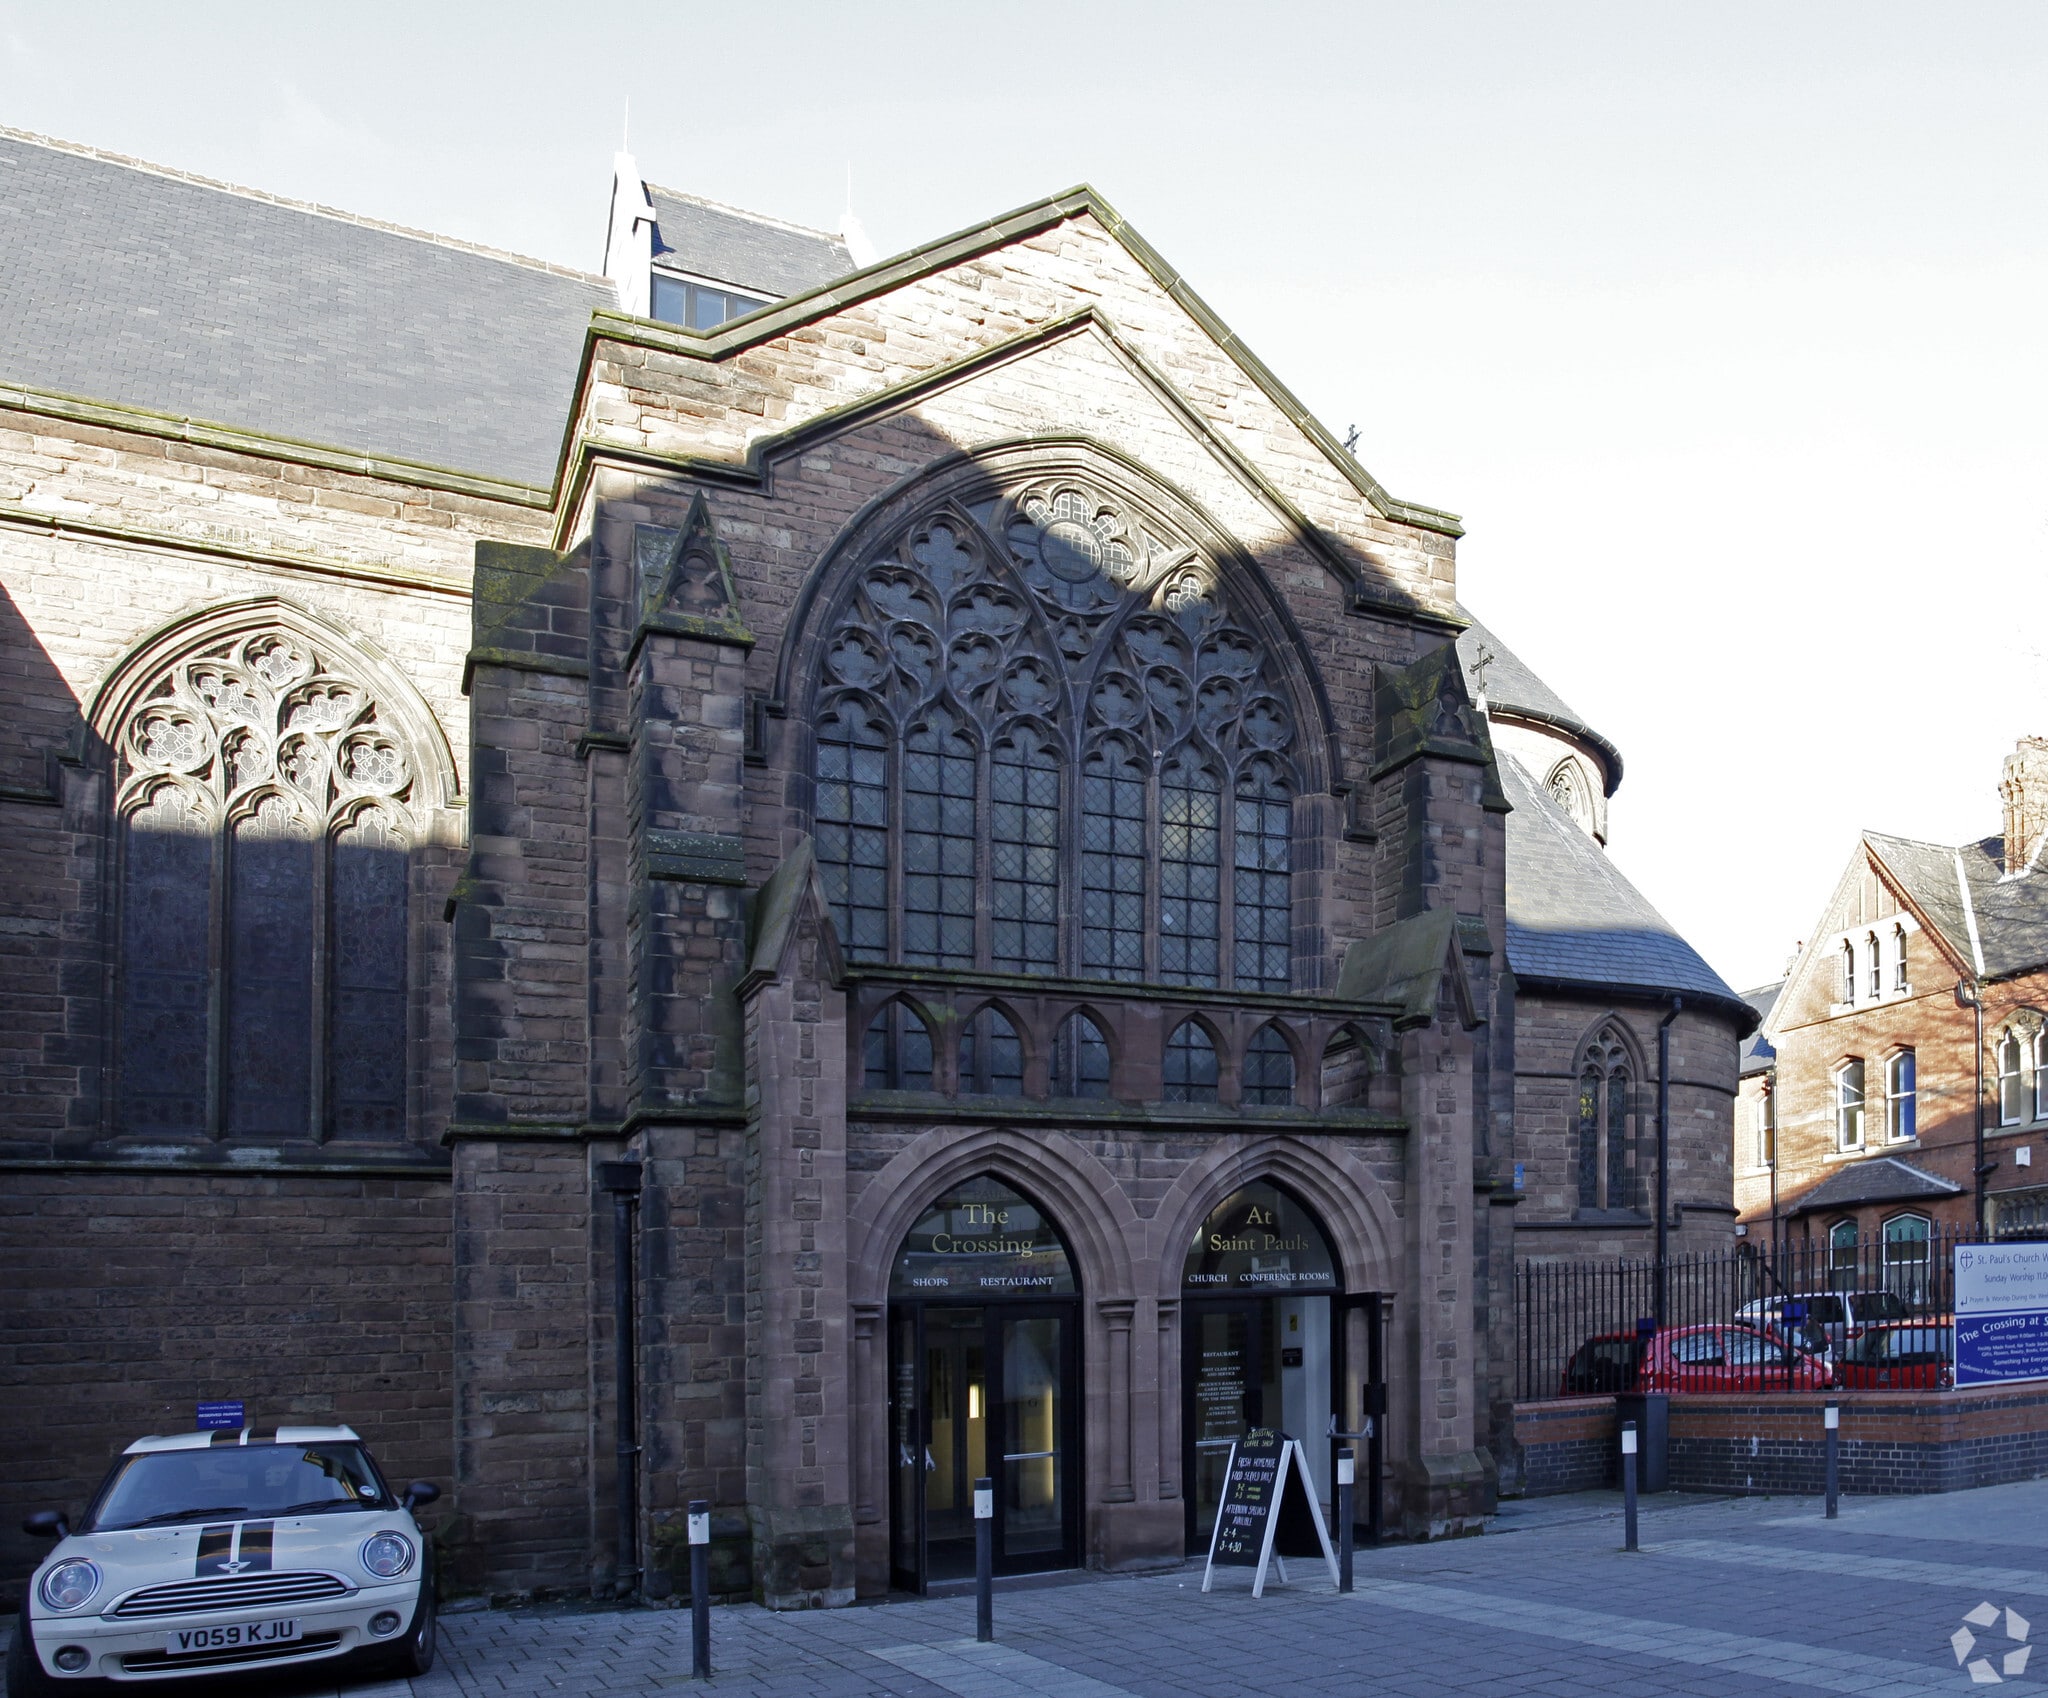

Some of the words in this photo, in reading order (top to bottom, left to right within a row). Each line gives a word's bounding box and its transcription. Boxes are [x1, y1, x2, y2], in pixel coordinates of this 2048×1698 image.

[962, 1203, 1009, 1224] The
[1246, 1205, 1273, 1225] At
[932, 1232, 1034, 1258] Crossing
[1210, 1233, 1257, 1252] Saint
[1264, 1233, 1309, 1251] Pauls
[1977, 1254, 1988, 1265] St.
[1989, 1253, 2011, 1264] Paul's
[2013, 1252, 2040, 1263] Church
[912, 1277, 949, 1287] SHOPS
[980, 1276, 1055, 1287] RESTAURANT
[1188, 1273, 1228, 1283] CHURCH
[1239, 1272, 1297, 1282] CONFERENCE
[1299, 1271, 1331, 1281] ROOMS
[1984, 1274, 2007, 1285] Sunday
[2010, 1272, 2035, 1284] Worship
[1992, 1295, 2011, 1303] Worship
[2012, 1294, 2028, 1302] During
[1958, 1329, 1980, 1344] The
[1982, 1316, 2026, 1334] Crossing
[2029, 1316, 2040, 1326] at
[2006, 1333, 2019, 1341] Open
[178, 1626, 241, 1649] VO59
[248, 1620, 294, 1642] KJU
